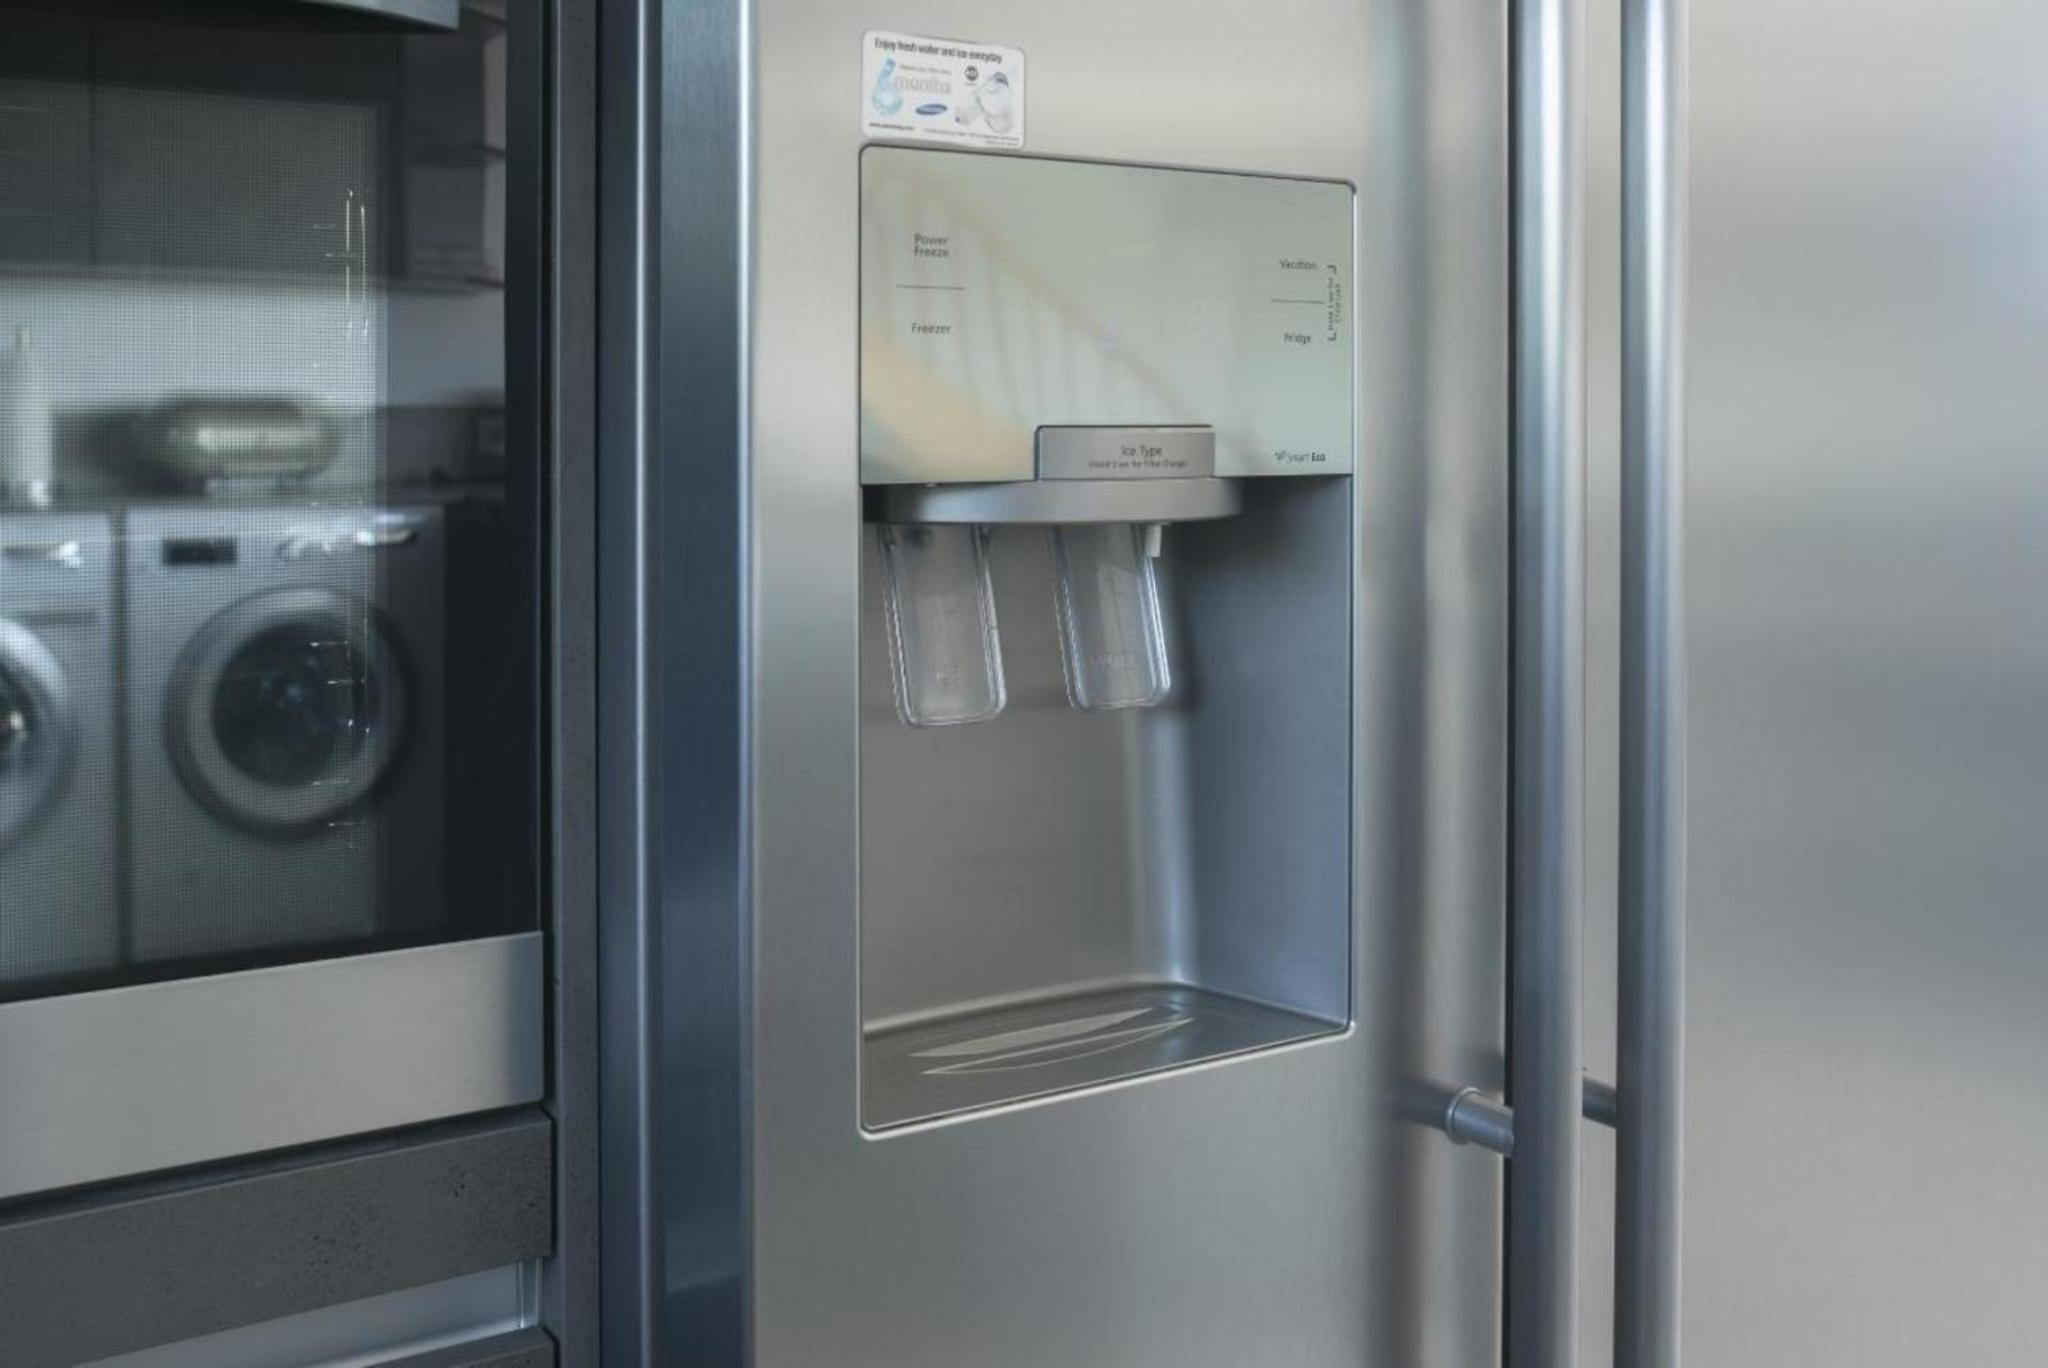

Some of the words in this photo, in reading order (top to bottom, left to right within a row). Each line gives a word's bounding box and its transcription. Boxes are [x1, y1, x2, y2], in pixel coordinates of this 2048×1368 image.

[874, 37, 896, 53] Enjoy
[897, 40, 918, 52] fresh
[918, 45, 939, 55] water
[940, 48, 956, 57] and
[968, 51, 1003, 65] everyday
[914, 233, 949, 245] Power
[914, 245, 950, 257] Freeze
[1279, 259, 1318, 270] Vacation
[911, 322, 951, 334] Freezer
[1283, 332, 1312, 345] Fridge
[1121, 444, 1136, 457] Ice
[1139, 444, 1163, 459] Type
[1311, 451, 1327, 462] Eco
